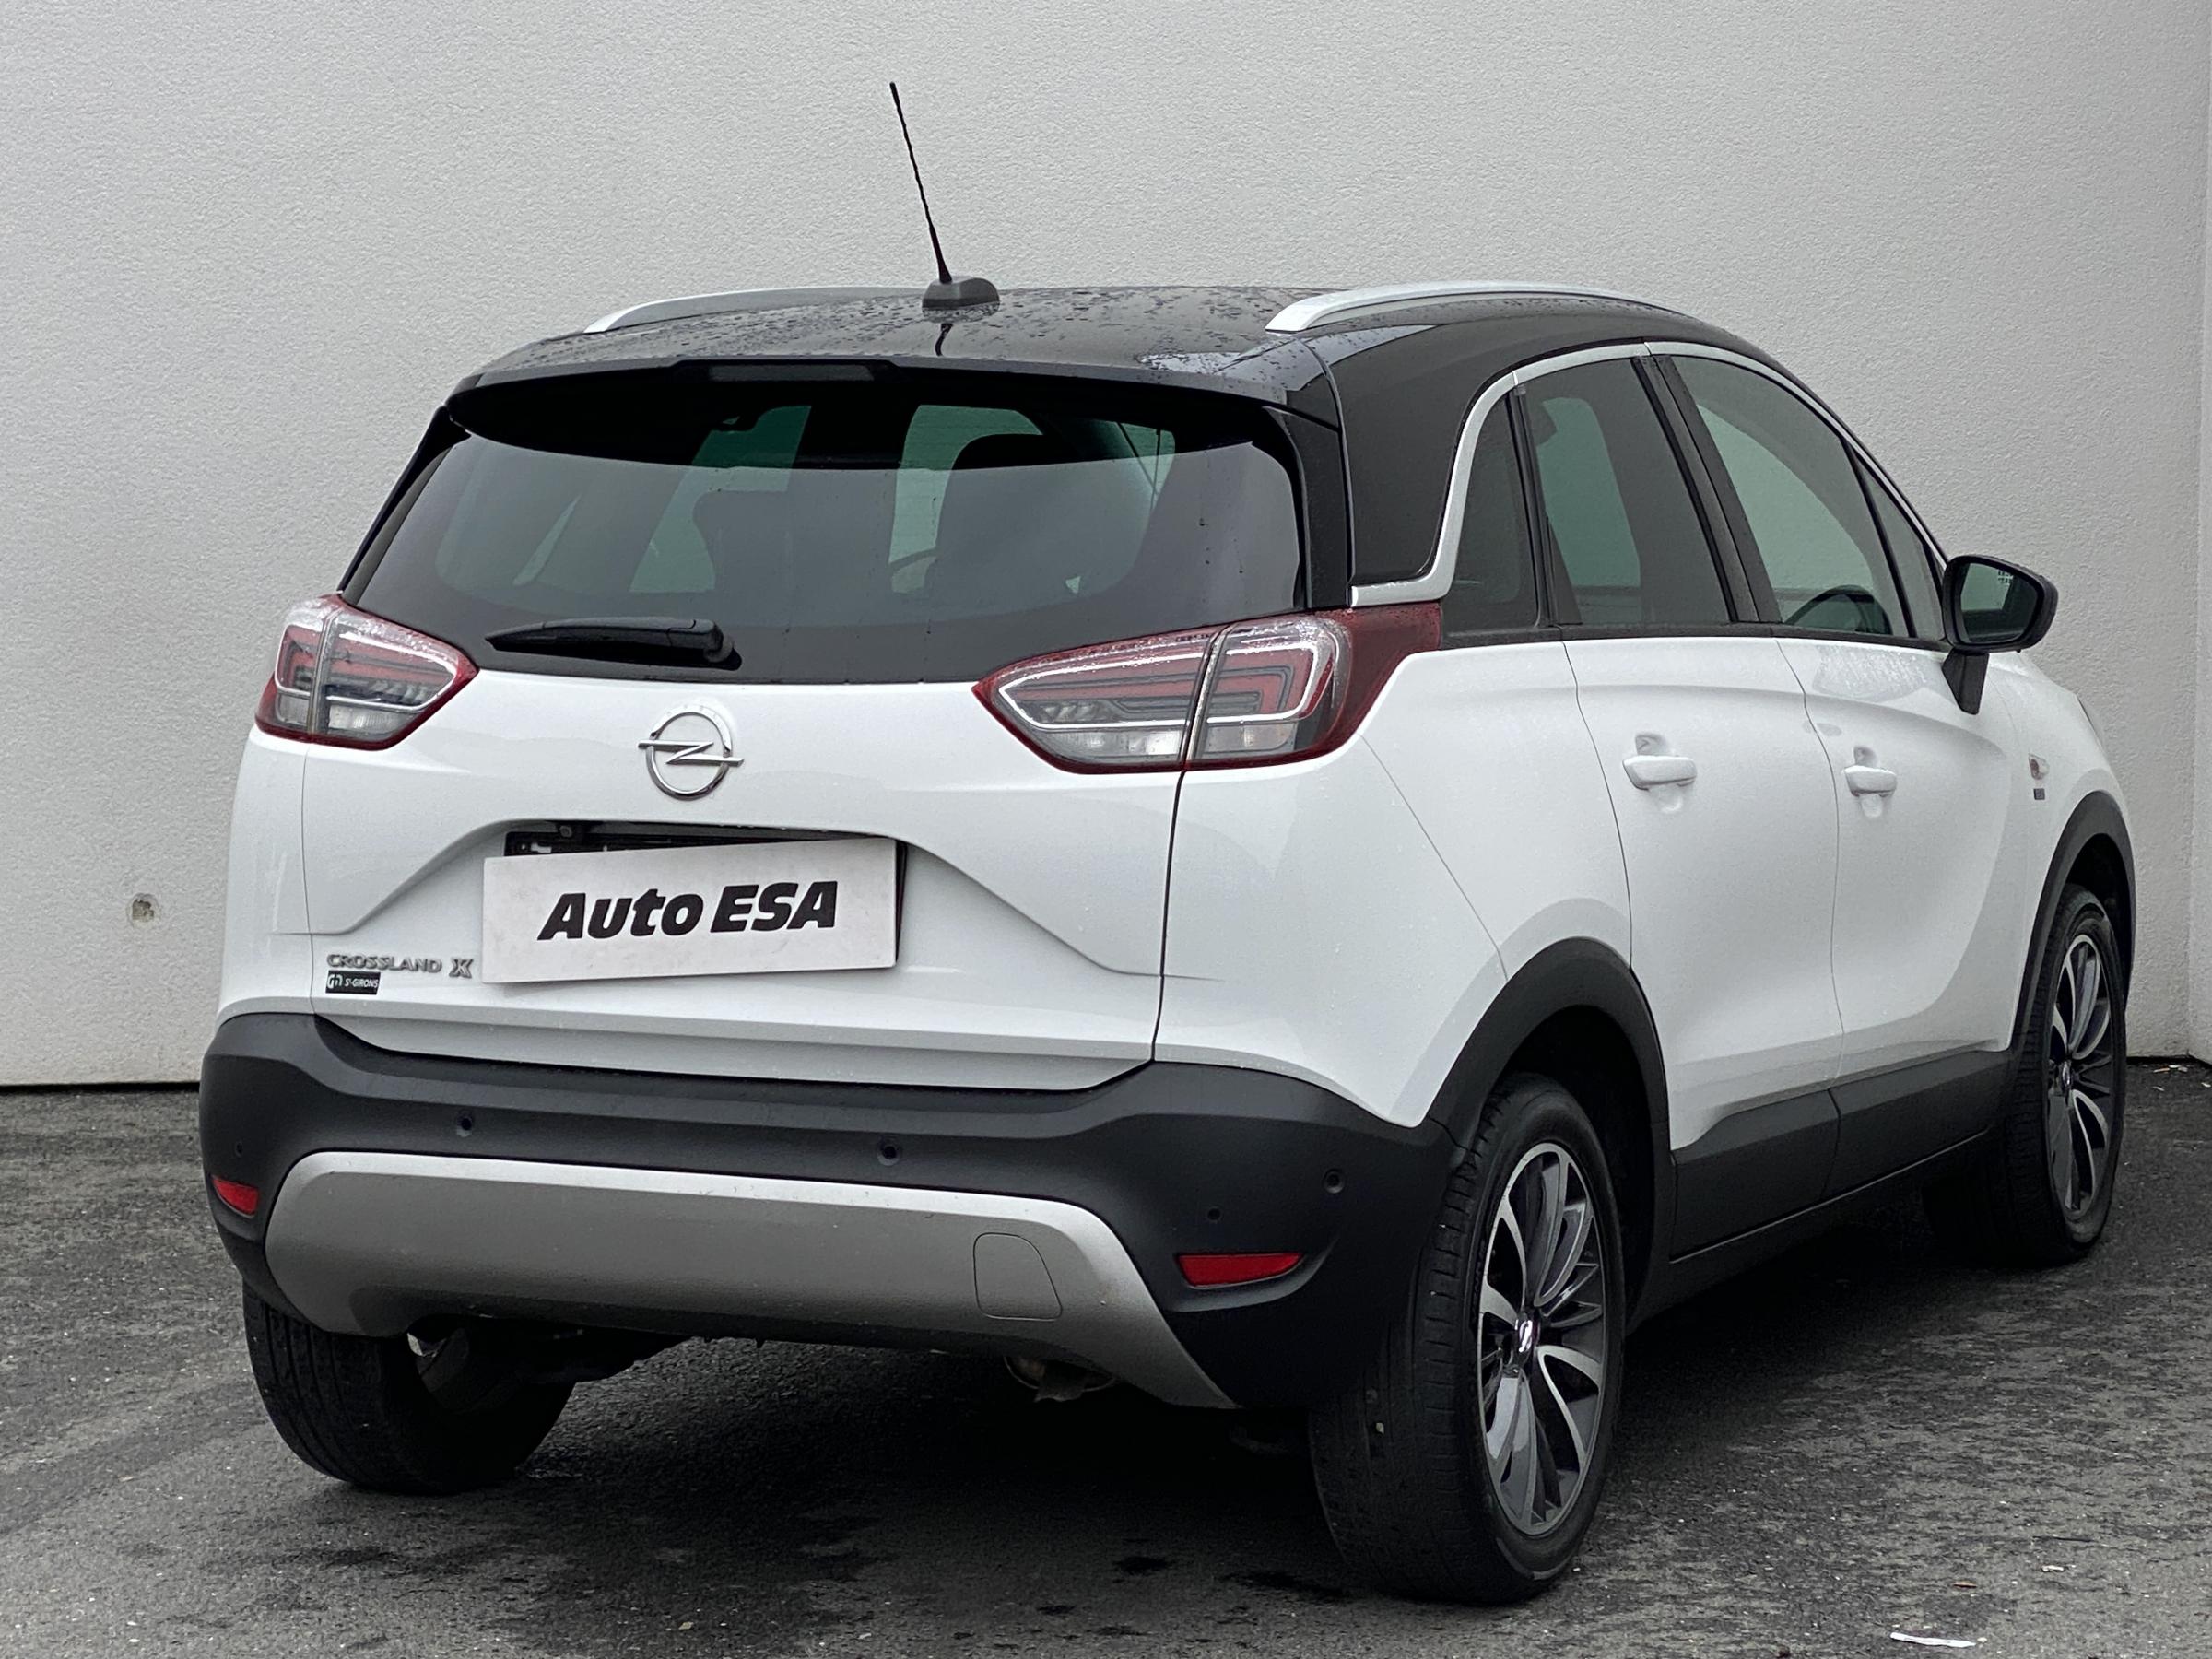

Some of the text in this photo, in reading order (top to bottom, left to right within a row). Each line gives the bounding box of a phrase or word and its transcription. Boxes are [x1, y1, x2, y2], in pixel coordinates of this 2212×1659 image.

[536, 880, 839, 941] Auto ESA
[327, 954, 474, 978] CROSSLAND X
